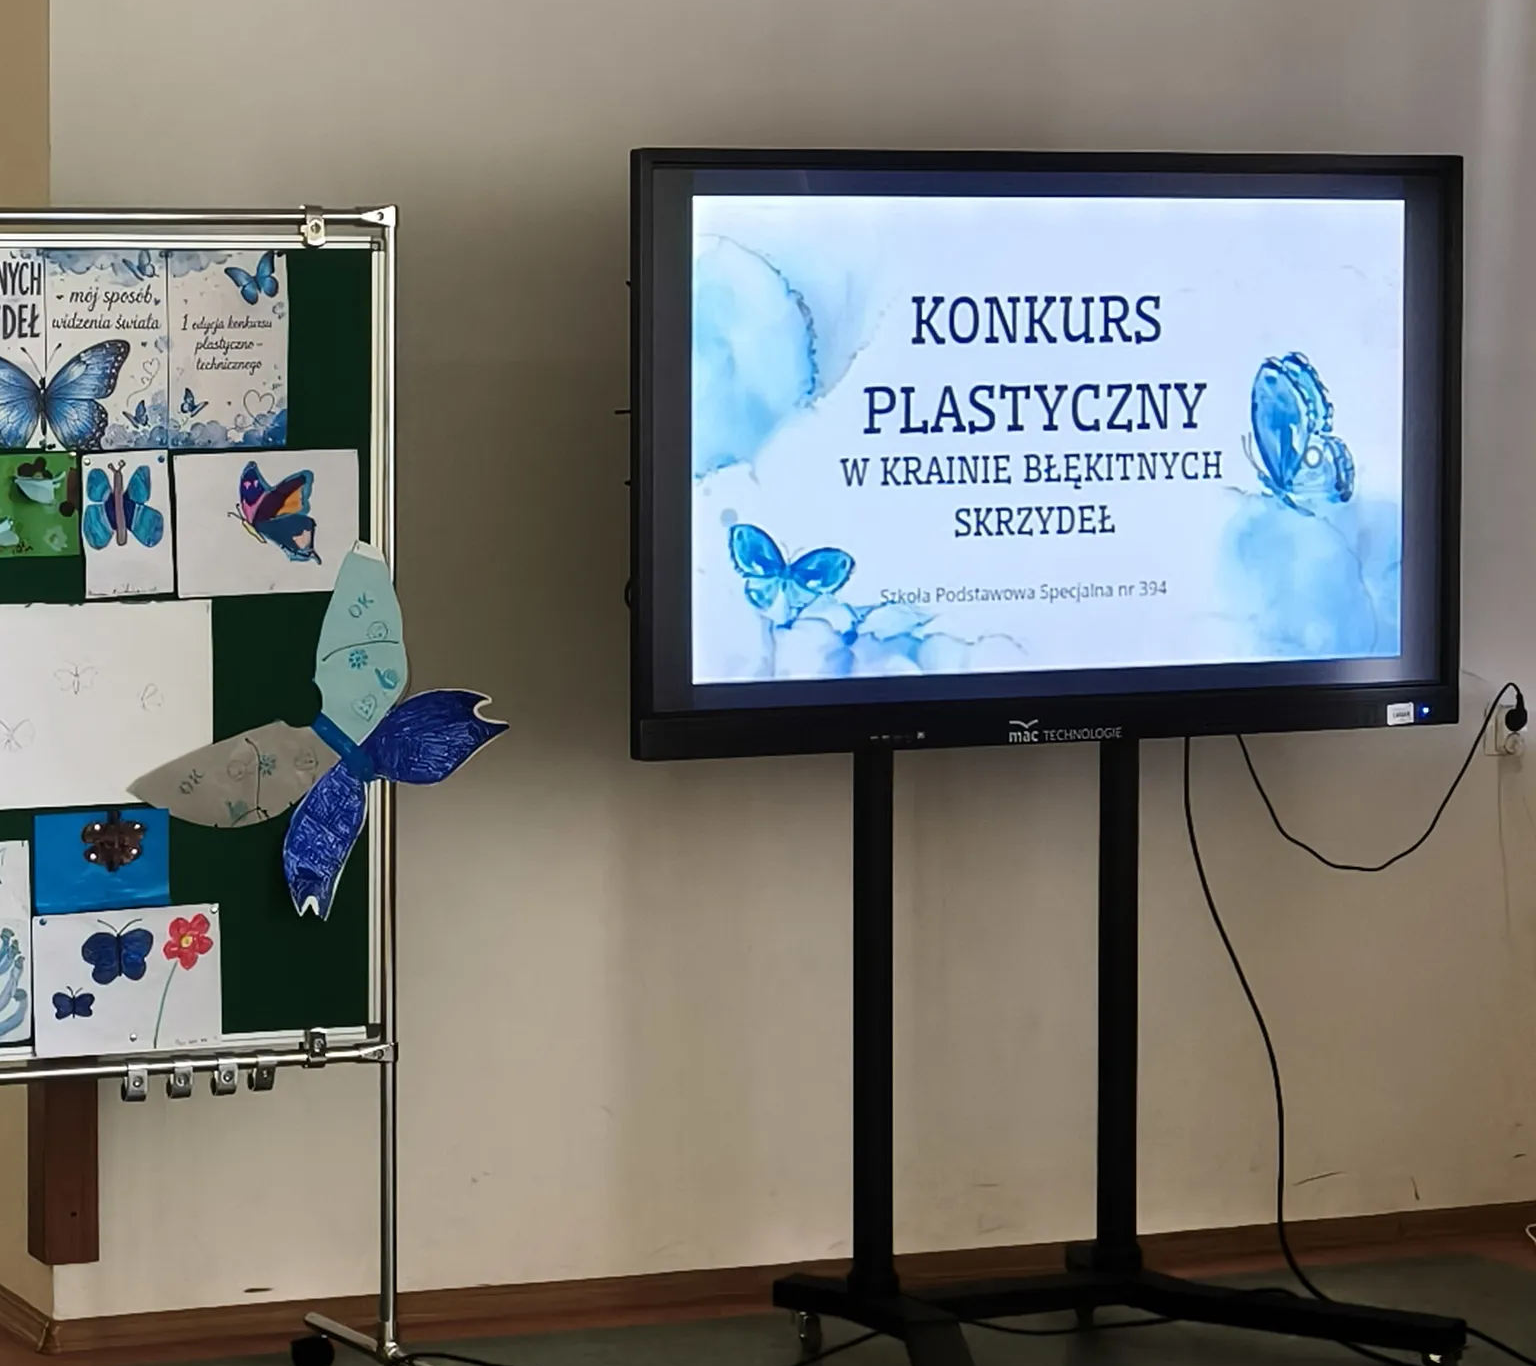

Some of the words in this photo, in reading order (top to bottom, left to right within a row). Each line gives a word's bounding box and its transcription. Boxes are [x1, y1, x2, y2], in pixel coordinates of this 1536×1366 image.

[69, 286, 99, 312] mój
[103, 284, 153, 311] sposób
[52, 312, 112, 330] widzenia
[115, 311, 161, 330] świata
[226, 314, 273, 330] konkursu
[911, 295, 1162, 345] KONKURS
[196, 356, 262, 376] technicznego
[863, 382, 1208, 435] PLASTYCZNY
[840, 457, 870, 487] W
[880, 454, 1012, 486] KRAINIE
[1023, 450, 1223, 489] BŁĘKITNYCH
[954, 505, 1116, 538] SKRZYDEŁ
[348, 592, 375, 619] OK
[880, 588, 931, 605] Szkoła
[935, 586, 1036, 604] Podstawowa
[1039, 582, 1114, 603] Specjalna
[1117, 584, 1135, 597] nr
[1138, 580, 1168, 597] 394
[1009, 729, 1039, 743] mac
[1042, 727, 1123, 742] TECHNOLOGIE
